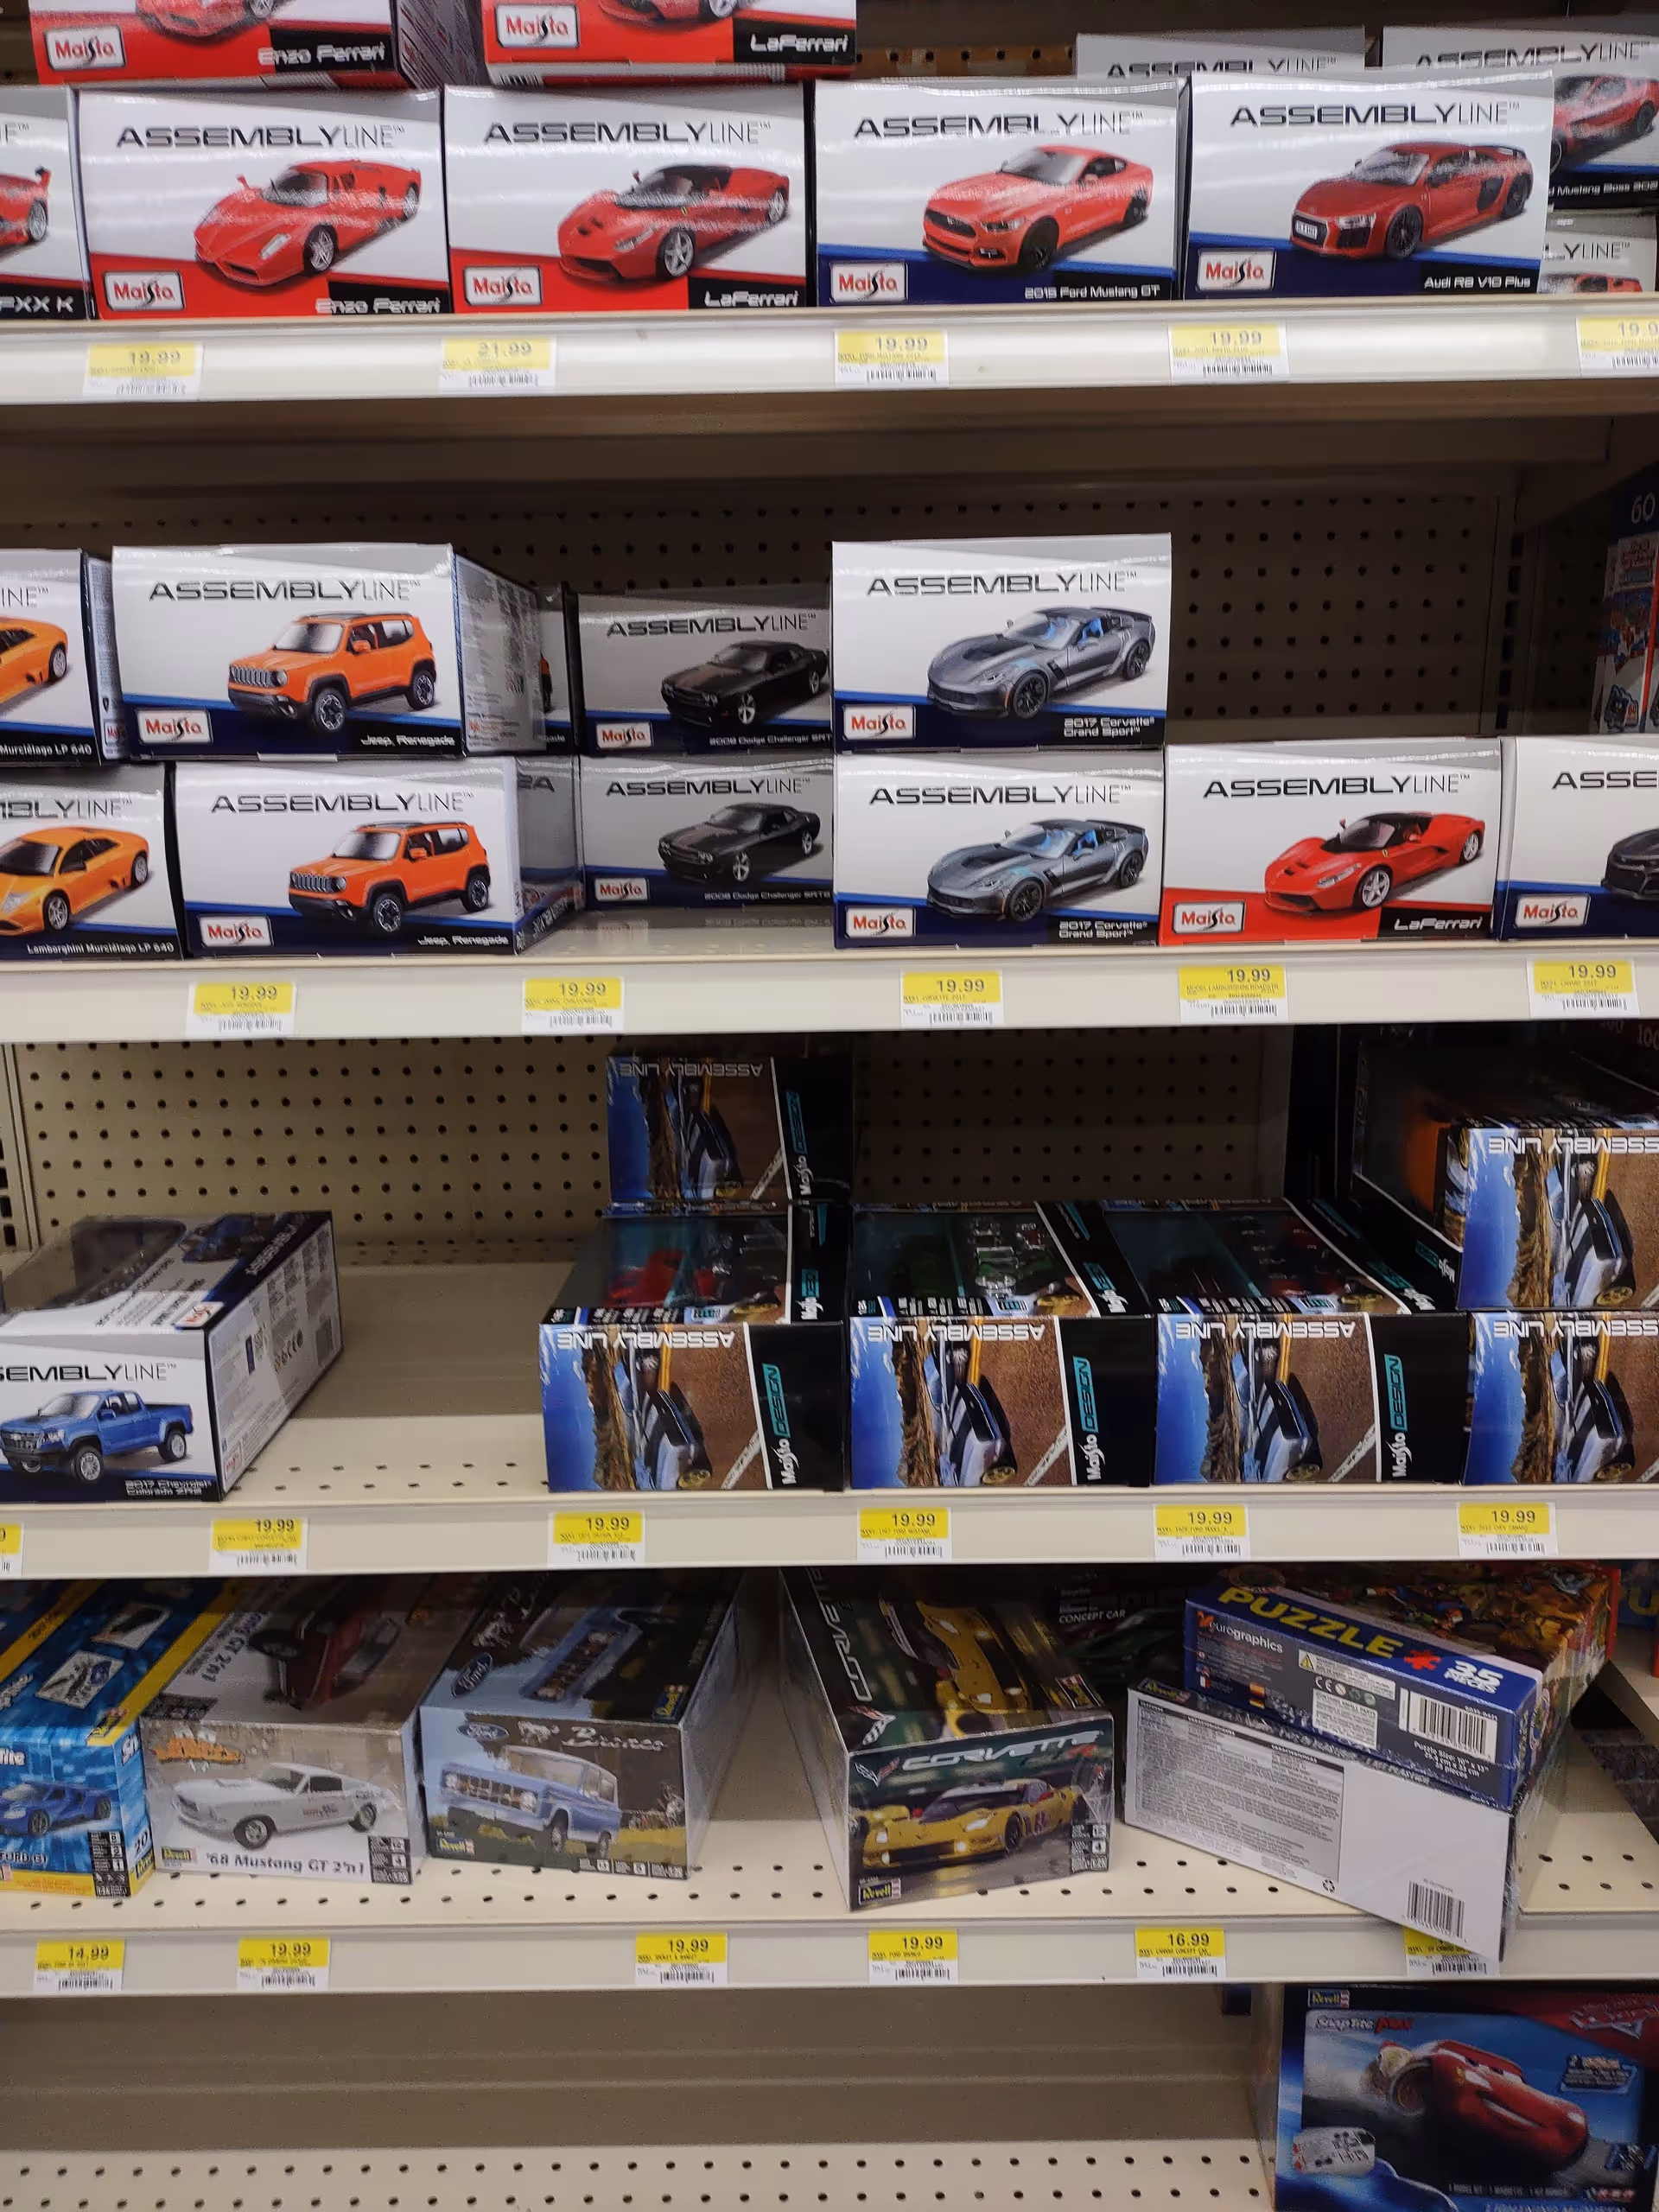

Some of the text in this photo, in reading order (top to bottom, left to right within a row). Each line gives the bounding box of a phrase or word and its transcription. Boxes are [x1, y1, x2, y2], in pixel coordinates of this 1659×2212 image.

[505, 16, 569, 39] Maisto
[55, 38, 116, 61] Maisto
[750, 35, 848, 53] LaFerrari
[257, 41, 385, 65] Enzo Ferrari
[1205, 261, 1264, 287] Maisto
[1424, 276, 1451, 289] Audi
[1478, 276, 1502, 288] V10
[1505, 276, 1531, 288] Plus
[473, 276, 533, 300] Maisto
[838, 271, 898, 295] Maisto
[1060, 286, 1087, 299] Ford
[1089, 284, 1138, 299] Mustang
[1141, 283, 1160, 297] GT
[112, 278, 175, 307] Maisto
[704, 290, 799, 307] LaFerrari
[316, 296, 441, 314] Enzo Ferrari
[876, 336, 928, 351] 19.99
[1211, 331, 1262, 346] 19.99
[130, 351, 181, 365] 19.99
[145, 717, 202, 739] Maisto
[851, 712, 907, 733] Maisto
[397, 734, 455, 747] Renegade
[601, 727, 646, 746] Maisto
[1064, 728, 1099, 738] Grand
[600, 883, 643, 900] Maisto
[1181, 910, 1236, 929] Maisto
[1523, 903, 1578, 922] Maisto
[854, 913, 906, 933] Maisto
[1394, 917, 1484, 931] LaFerrari
[207, 923, 263, 944] Maisto
[452, 934, 509, 947] Renegade
[27, 943, 84, 956] Lamborghini
[1227, 968, 1271, 982] 19.99
[1568, 964, 1617, 978] 19.99
[232, 986, 277, 1001] 19.99
[559, 982, 607, 996] 19.99
[937, 979, 984, 993] 19.99
[620, 1062, 763, 1077] ASSEMBLY LINE
[1489, 1137, 1542, 1154] LINE
[795, 1155, 817, 1196] Maisto
[868, 1324, 1046, 1342] ASSEMBLY LINE
[1175, 1321, 1356, 1339] ASSEMBLY LINE
[1493, 1320, 1546, 1338] LINE
[557, 1331, 734, 1348] ASSEMBLY LINE
[765, 1364, 799, 1484] Maisto DESIGN
[1076, 1358, 1106, 1480] Maisto DESIGN
[1385, 1356, 1412, 1478] Maisto DESIGN
[586, 1516, 630, 1530] 19.99
[892, 1513, 935, 1527] 19.99
[1188, 1511, 1232, 1524] 19.99
[1491, 1510, 1535, 1523] 19.99
[254, 1519, 295, 1533] 19.99
[1107, 1609, 1126, 1620] CAR
[1218, 1586, 1405, 1659] PUZZLE
[1210, 1621, 1283, 1654] eurographics
[1455, 1660, 1504, 1688] 35
[234, 1854, 302, 1874] Mustang
[308, 1859, 329, 1872] GT
[668, 1938, 709, 1953] 19.99
[902, 1936, 943, 1949] 19.99
[1167, 1933, 1209, 1947] 16.99
[270, 1942, 311, 1957] 19.99
